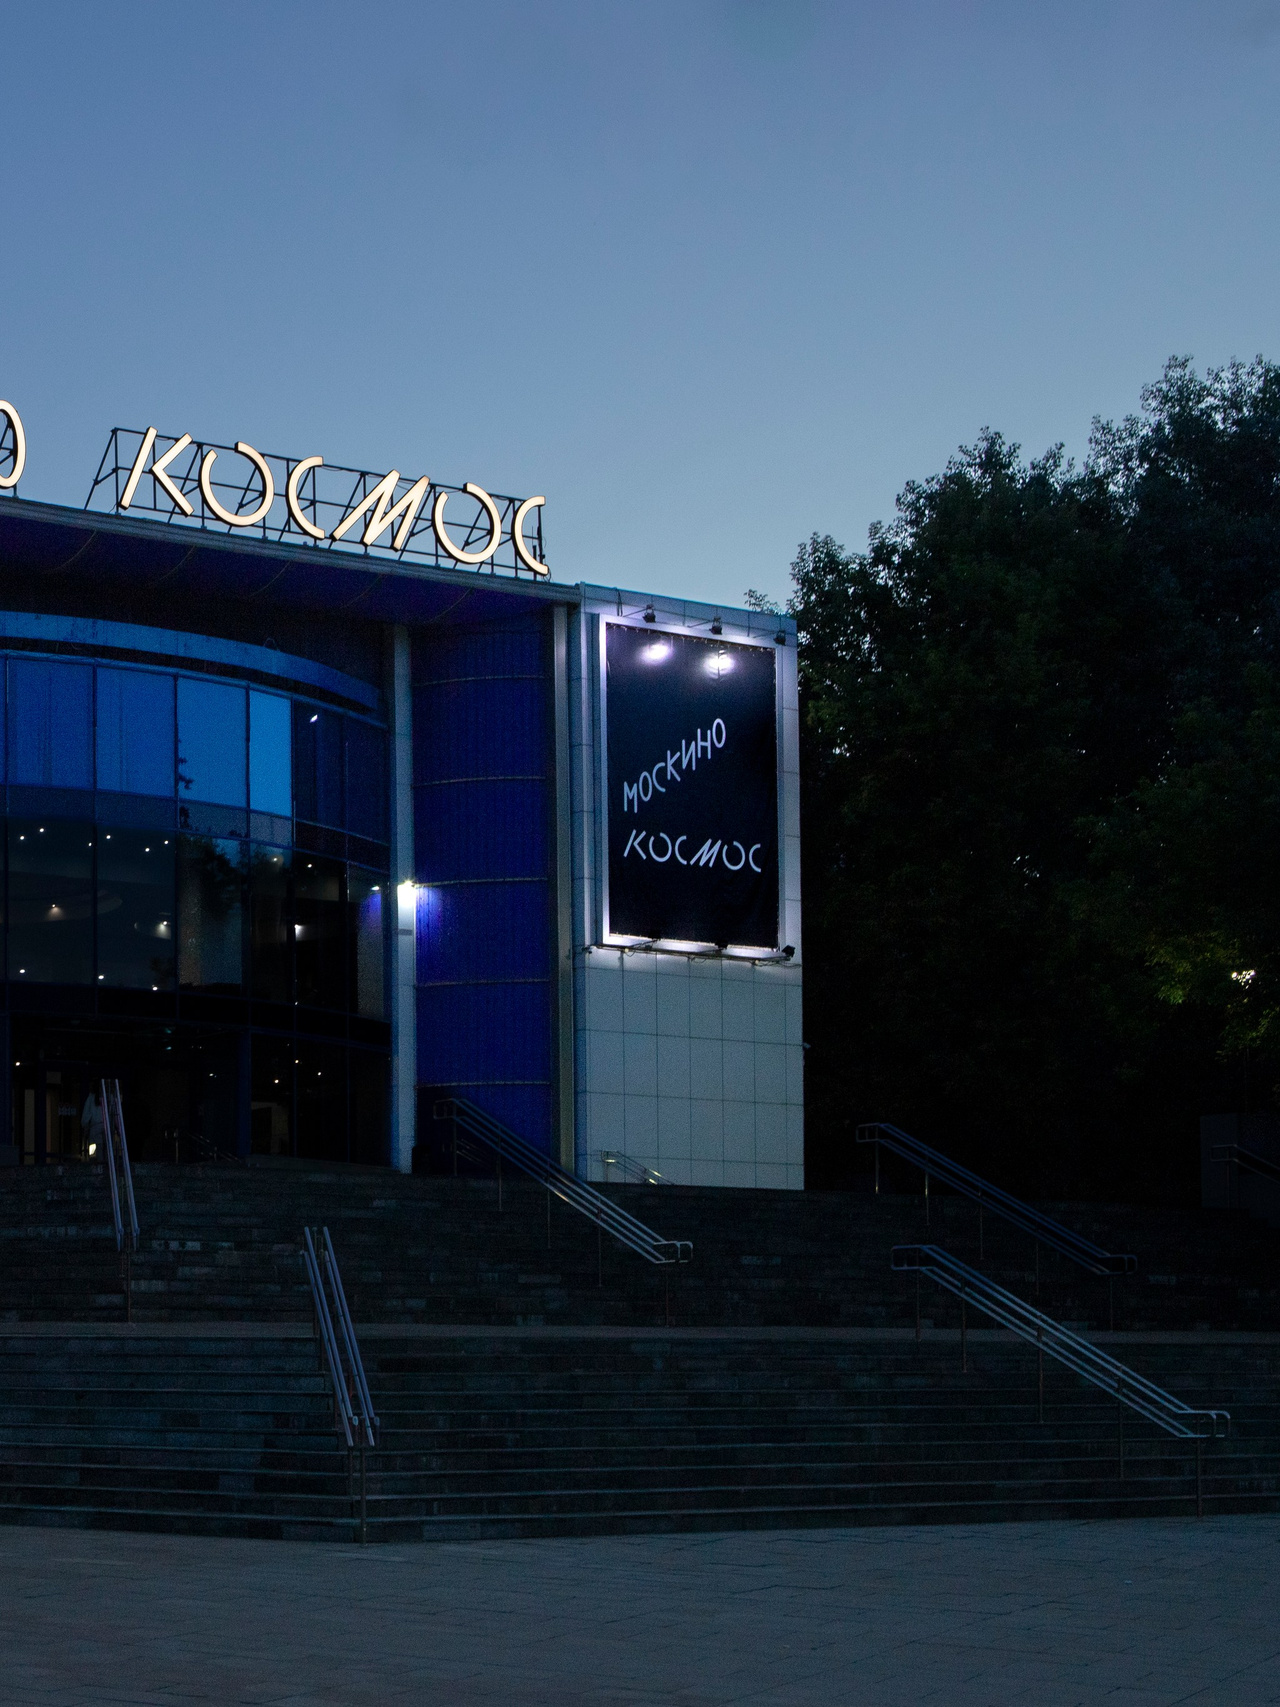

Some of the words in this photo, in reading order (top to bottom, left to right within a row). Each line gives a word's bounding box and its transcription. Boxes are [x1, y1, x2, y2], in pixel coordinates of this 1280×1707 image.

[120, 426, 549, 576] КОСМОС
[623, 718, 726, 813] МОСКИНО
[623, 829, 762, 873] КОСМОС
